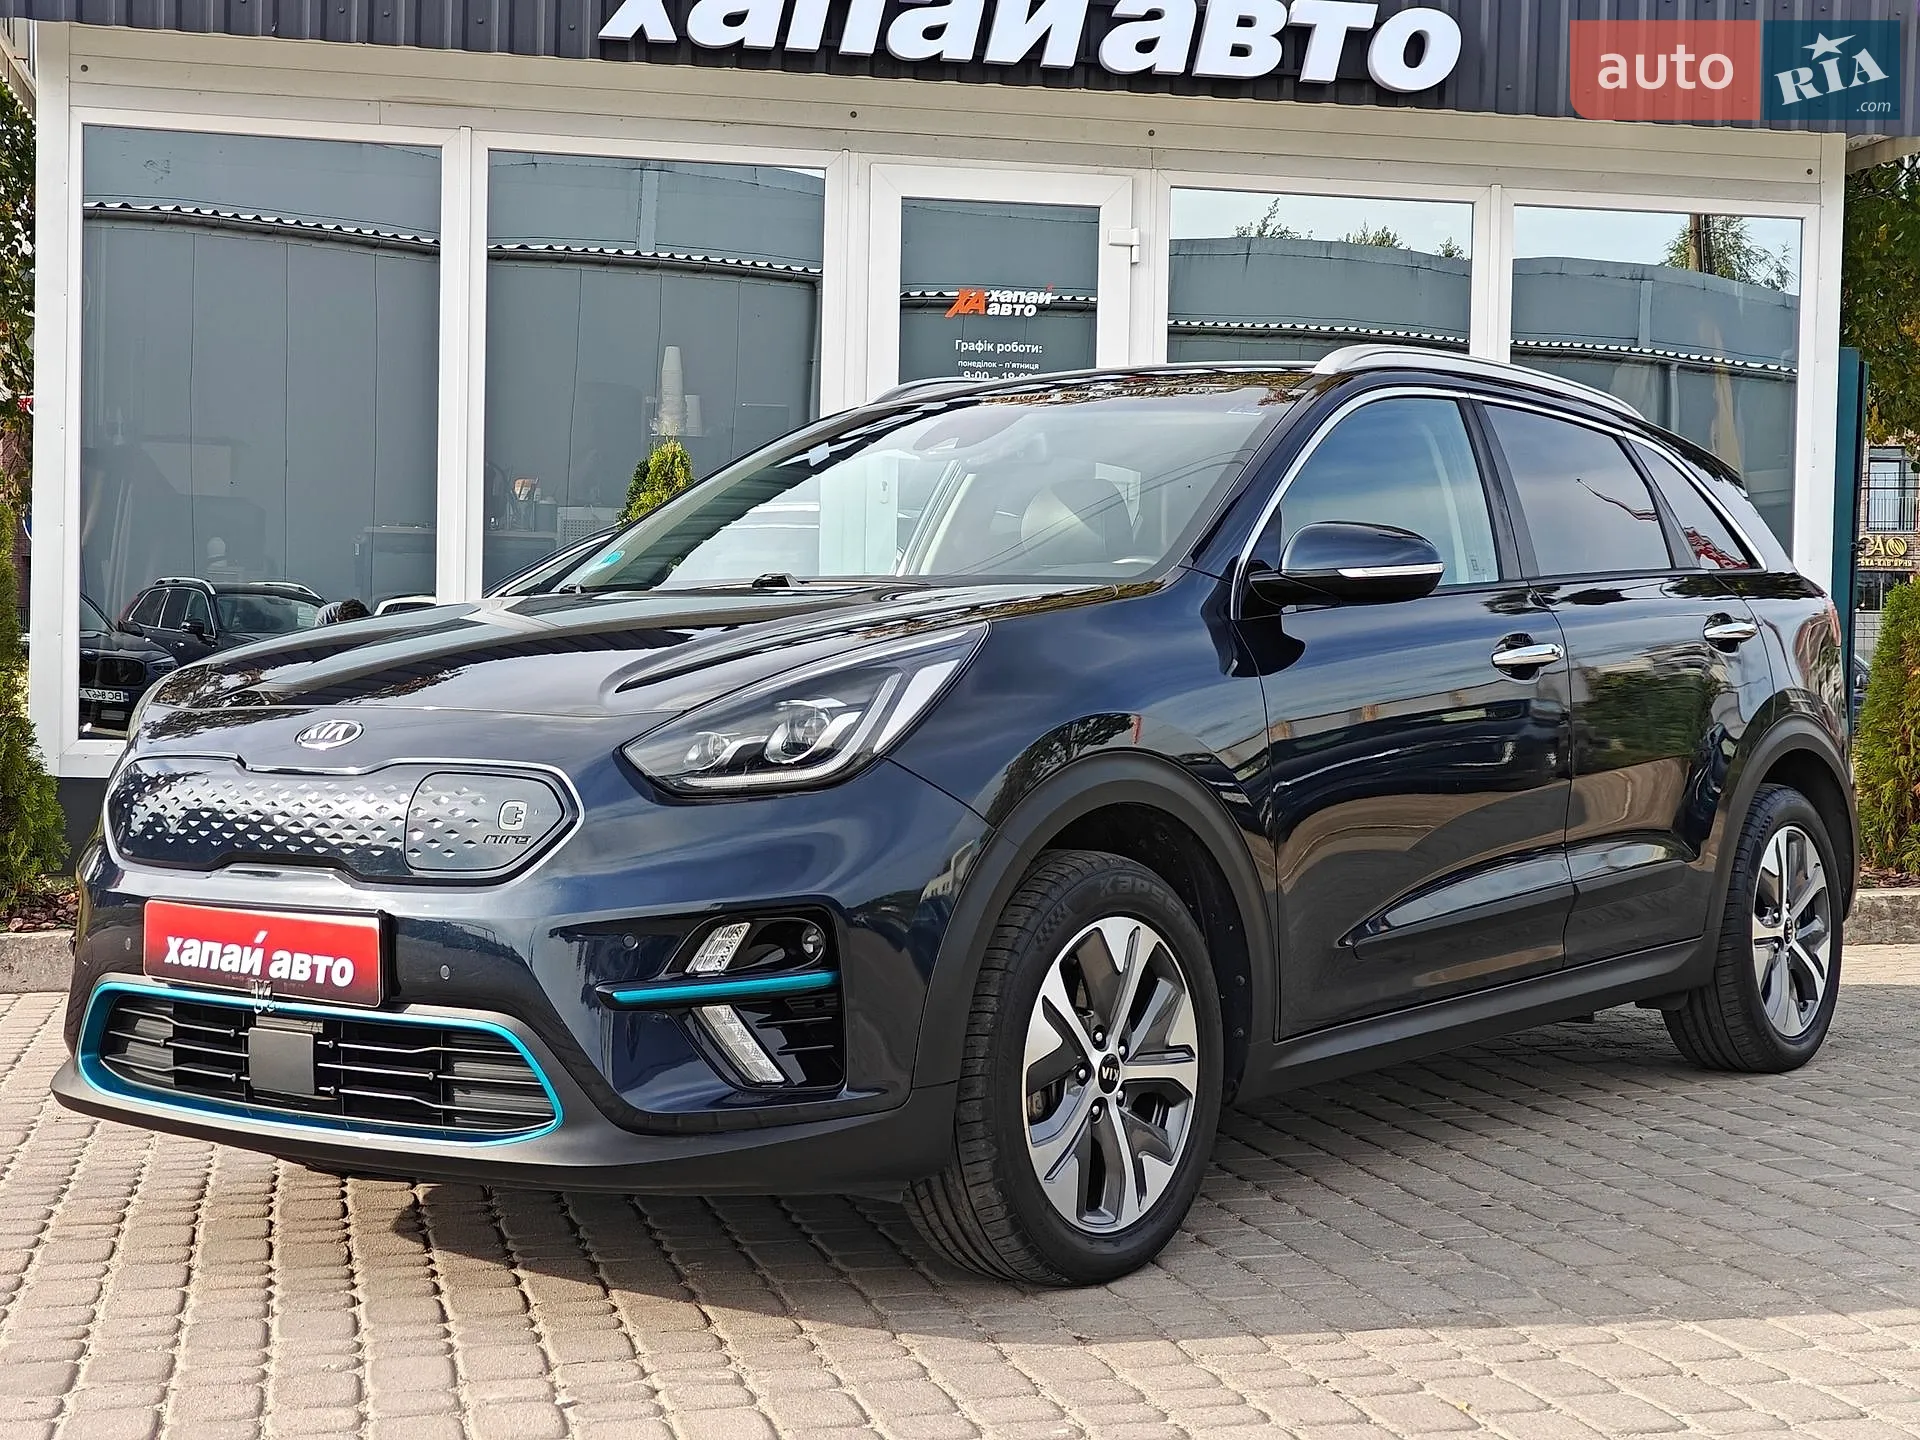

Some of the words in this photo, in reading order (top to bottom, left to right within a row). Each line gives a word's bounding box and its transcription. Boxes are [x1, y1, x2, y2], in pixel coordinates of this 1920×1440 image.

[1097, 0, 1463, 92] авто
[986, 303, 1037, 317] авто
[955, 340, 994, 353] Графік
[996, 342, 1043, 354] роботи:
[958, 360, 997, 369] понеділок
[268, 949, 354, 987] авто
[1101, 1065, 1120, 1082] KIA
